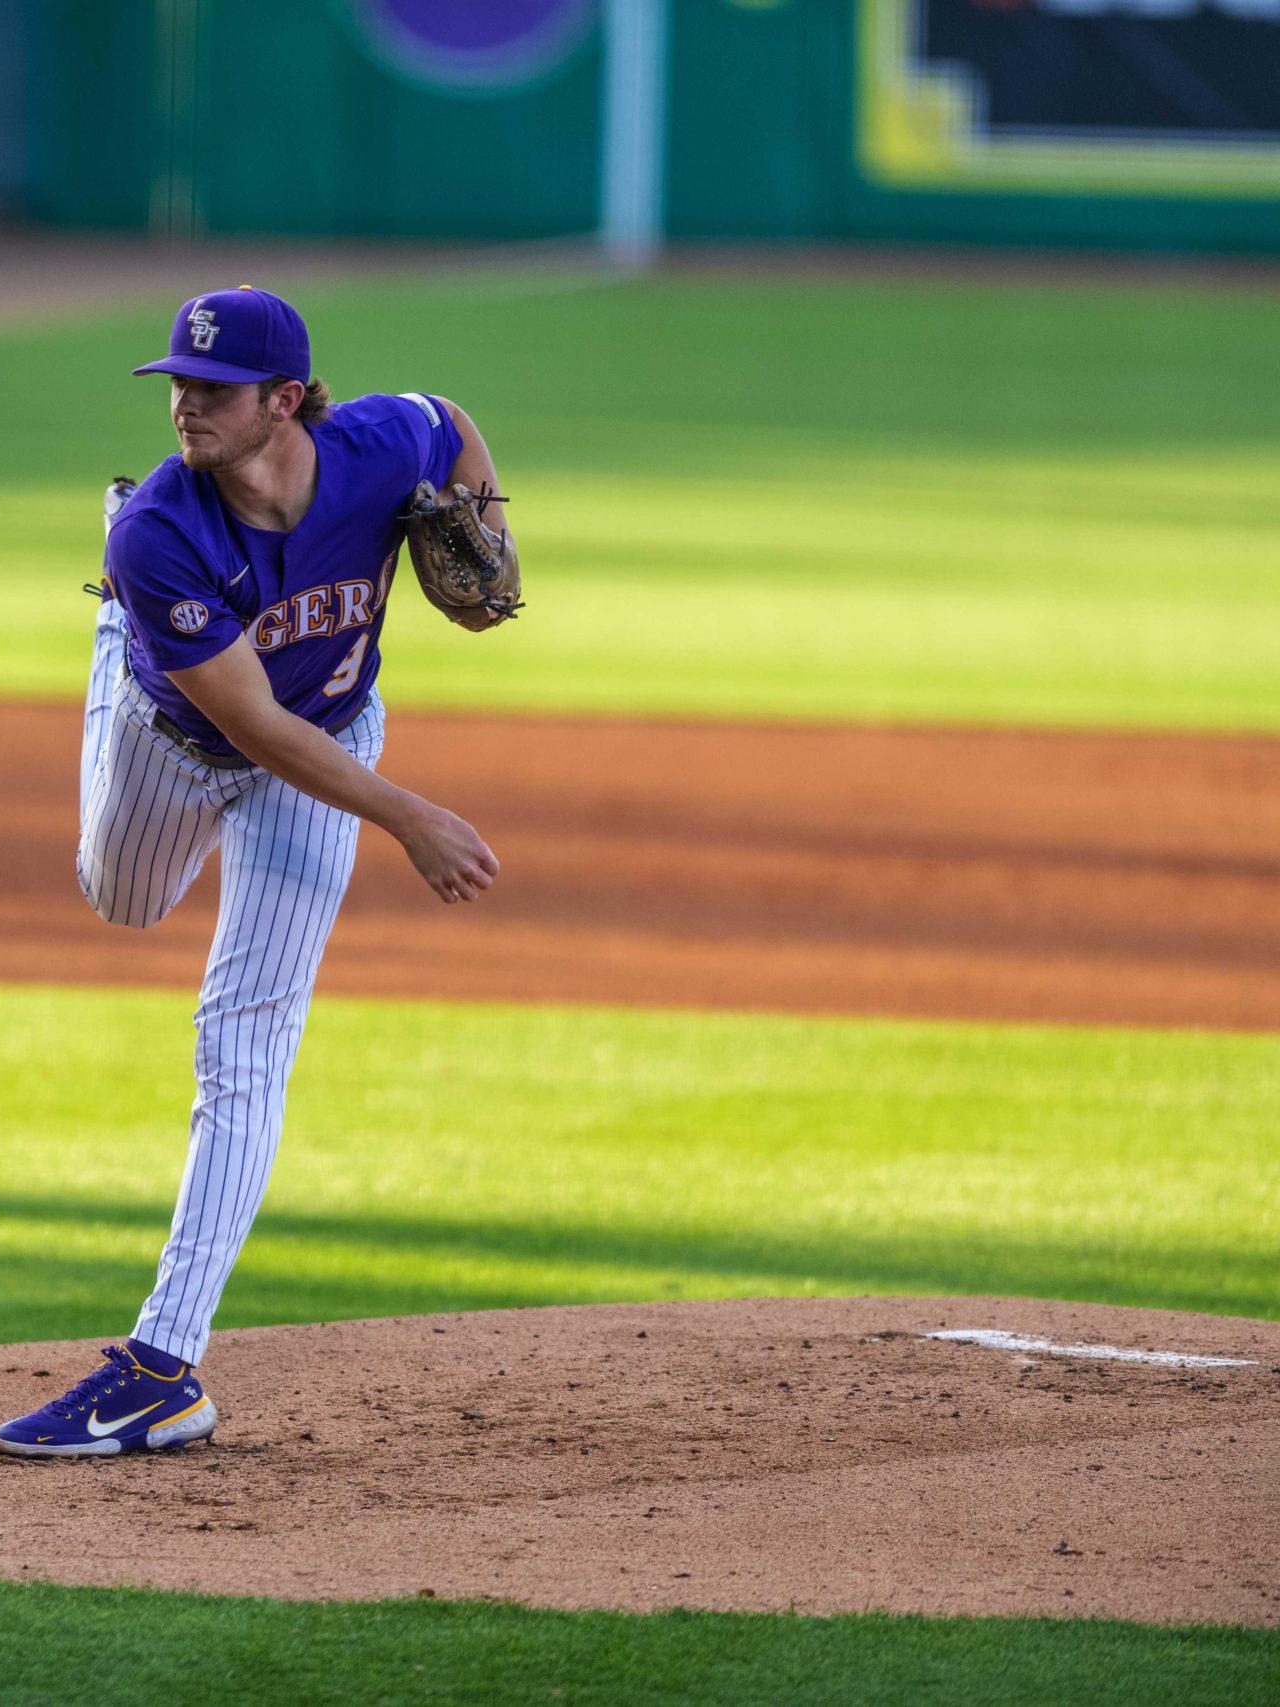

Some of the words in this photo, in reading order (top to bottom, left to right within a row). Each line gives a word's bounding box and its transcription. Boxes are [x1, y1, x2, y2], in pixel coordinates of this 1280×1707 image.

[187, 299, 220, 351] LSU
[172, 603, 206, 631] SEC
[323, 632, 369, 697] 9
